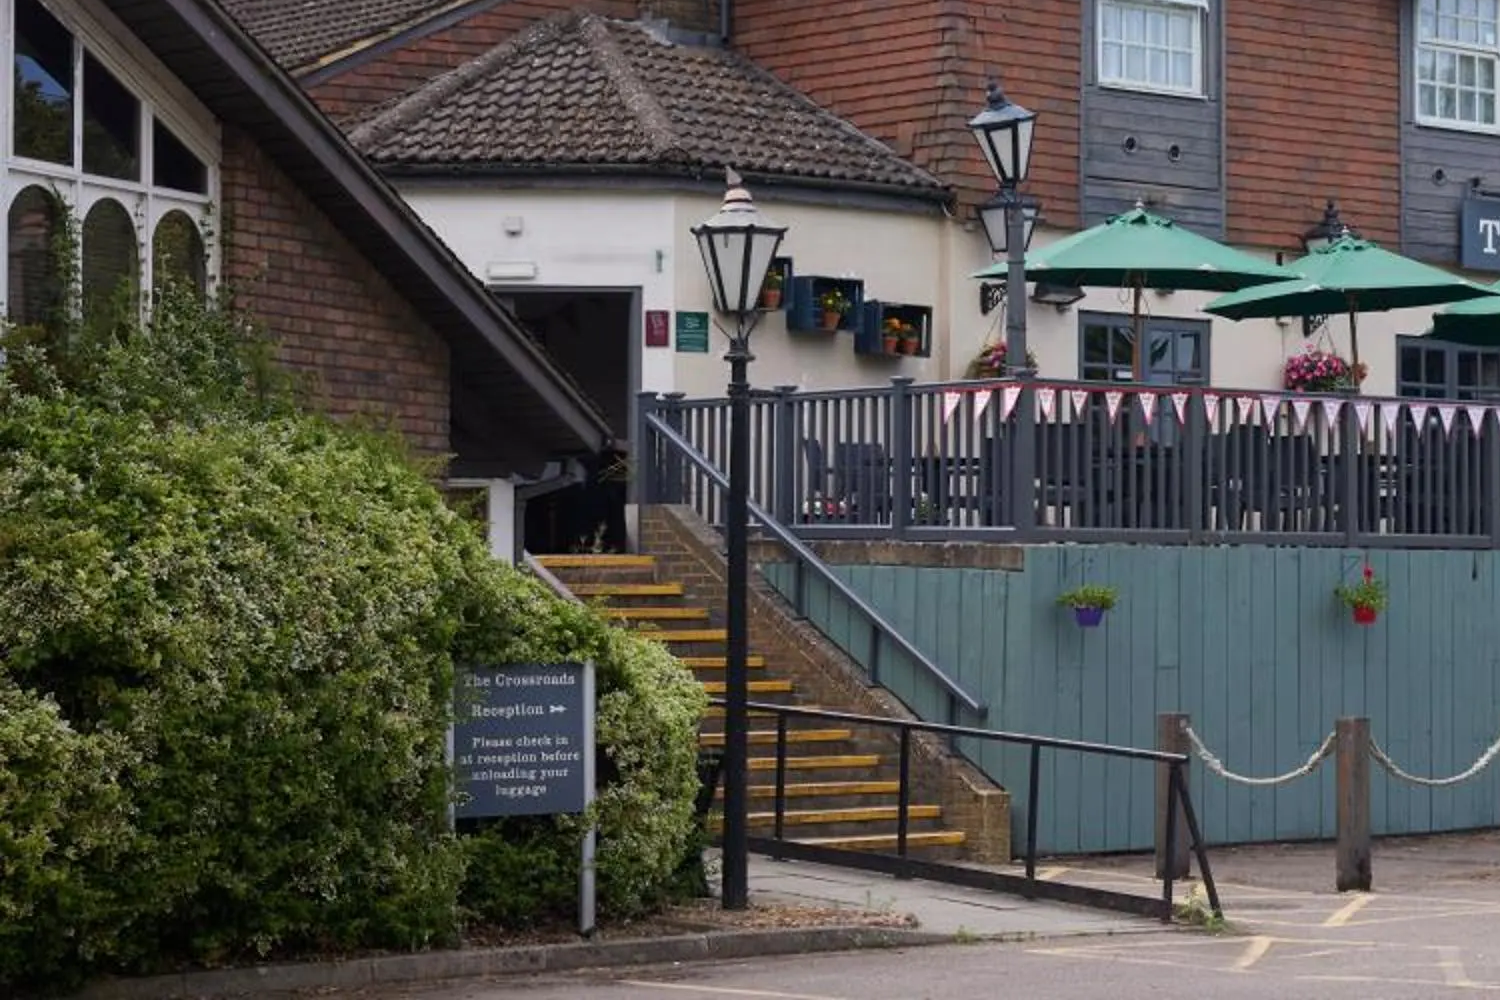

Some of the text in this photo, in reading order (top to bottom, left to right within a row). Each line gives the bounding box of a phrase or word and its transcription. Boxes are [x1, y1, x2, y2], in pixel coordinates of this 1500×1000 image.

[463, 673, 575, 687] The Crossroads
[471, 703, 544, 719] Reception
[472, 735, 569, 748] Please check in
[460, 750, 580, 766] at reception before
[471, 767, 568, 781] unloading your
[495, 784, 547, 798] luggage
